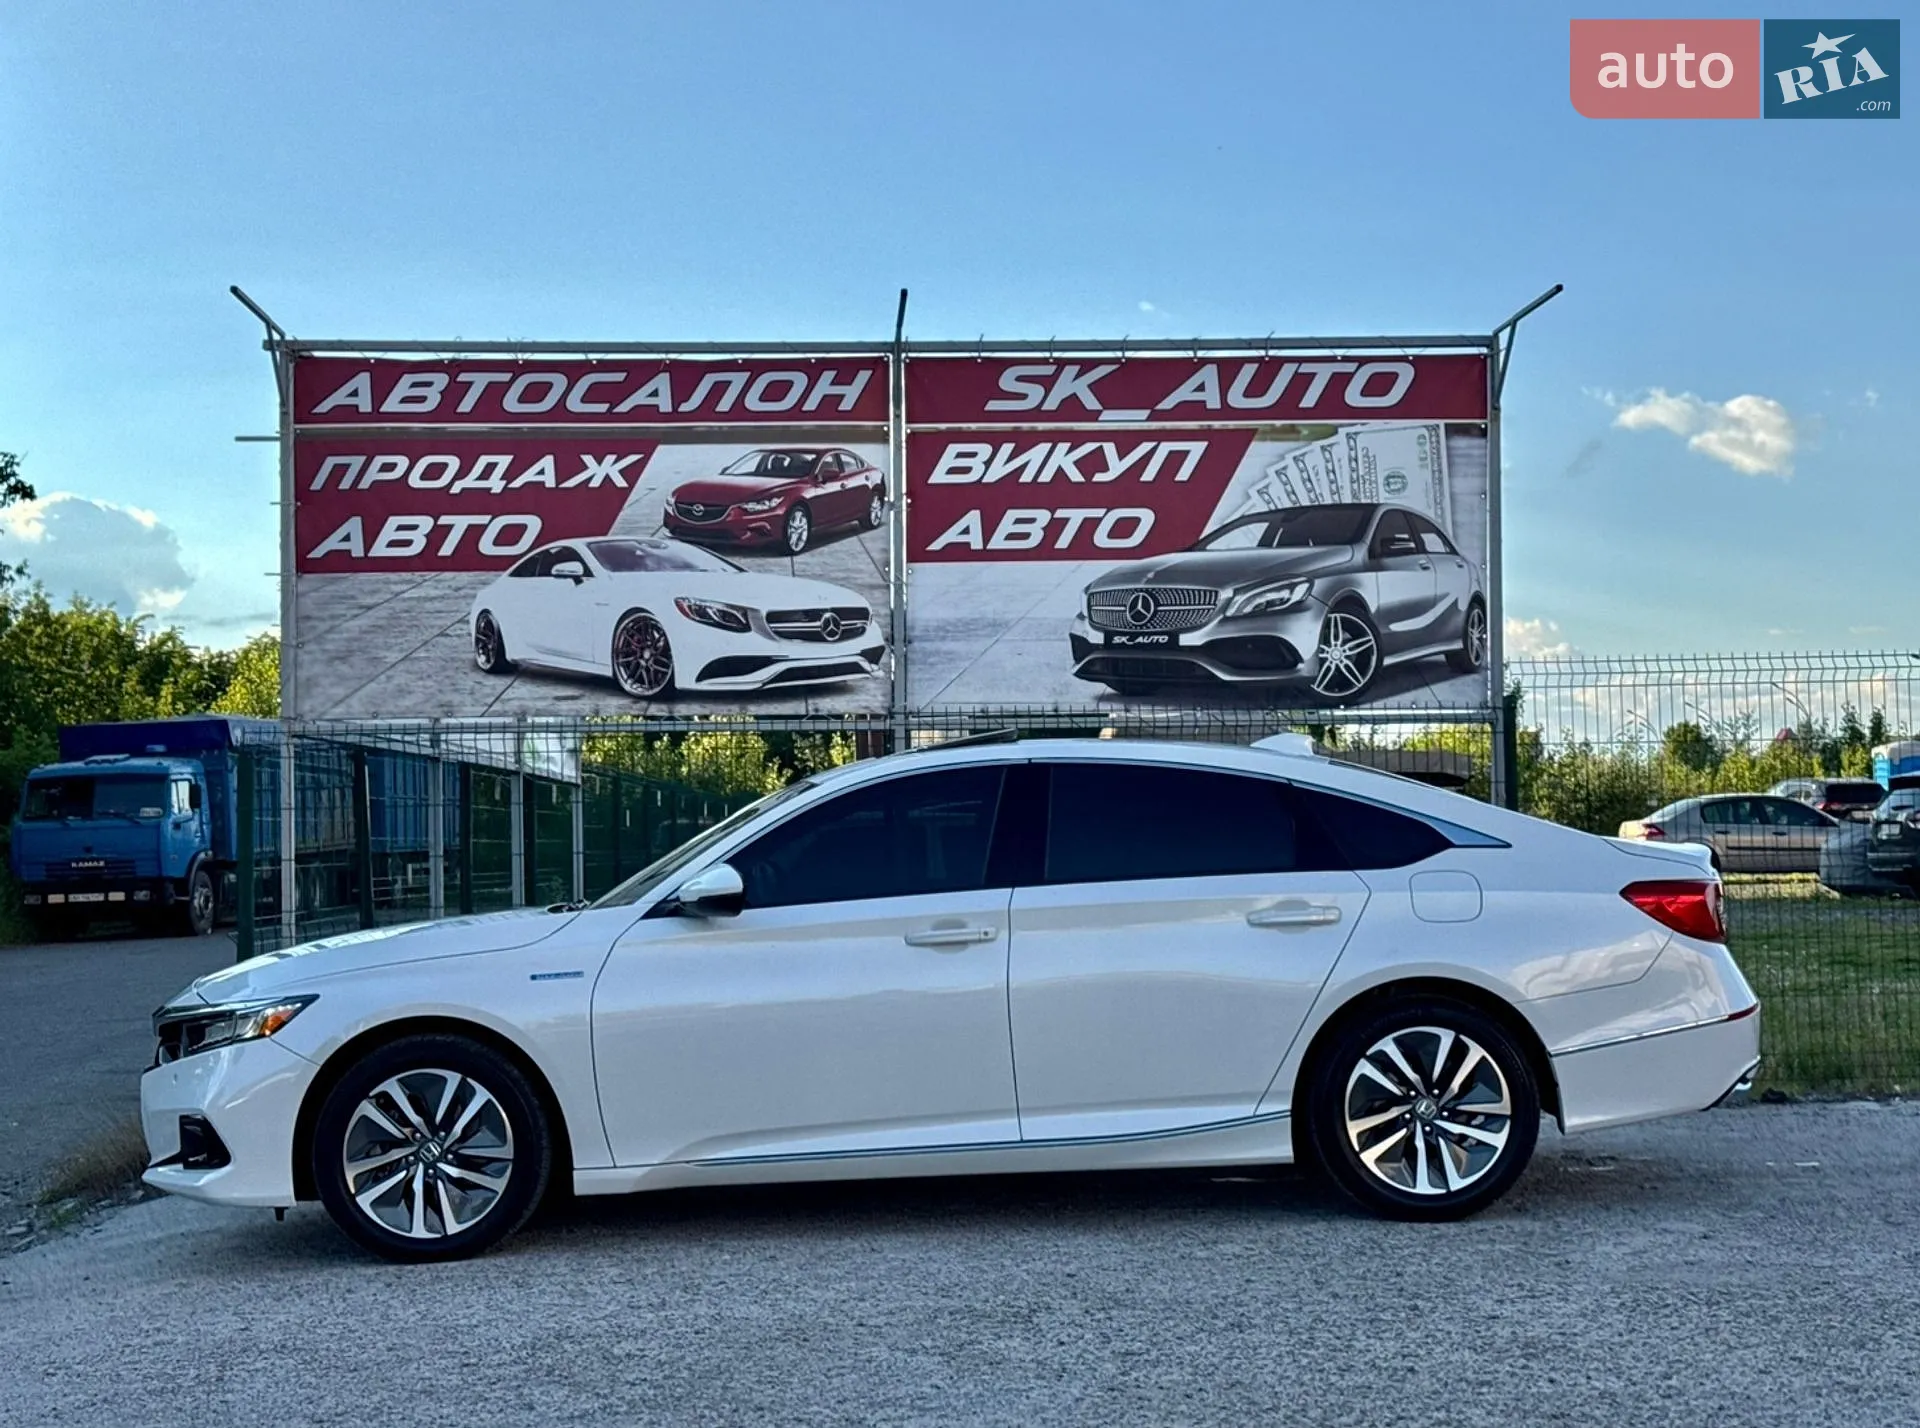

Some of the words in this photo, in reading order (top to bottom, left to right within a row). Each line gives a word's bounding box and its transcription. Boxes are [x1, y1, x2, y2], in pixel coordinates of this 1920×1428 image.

[312, 371, 873, 414] АВТОСАЛОН
[985, 362, 1416, 421] SK_AUTO
[309, 454, 645, 493] ПРОДАЖ
[928, 441, 1209, 484] ВИКУП
[307, 515, 543, 559] АВТО
[927, 508, 1156, 551] АВТО
[1111, 635, 1169, 645] SK_AUTO
